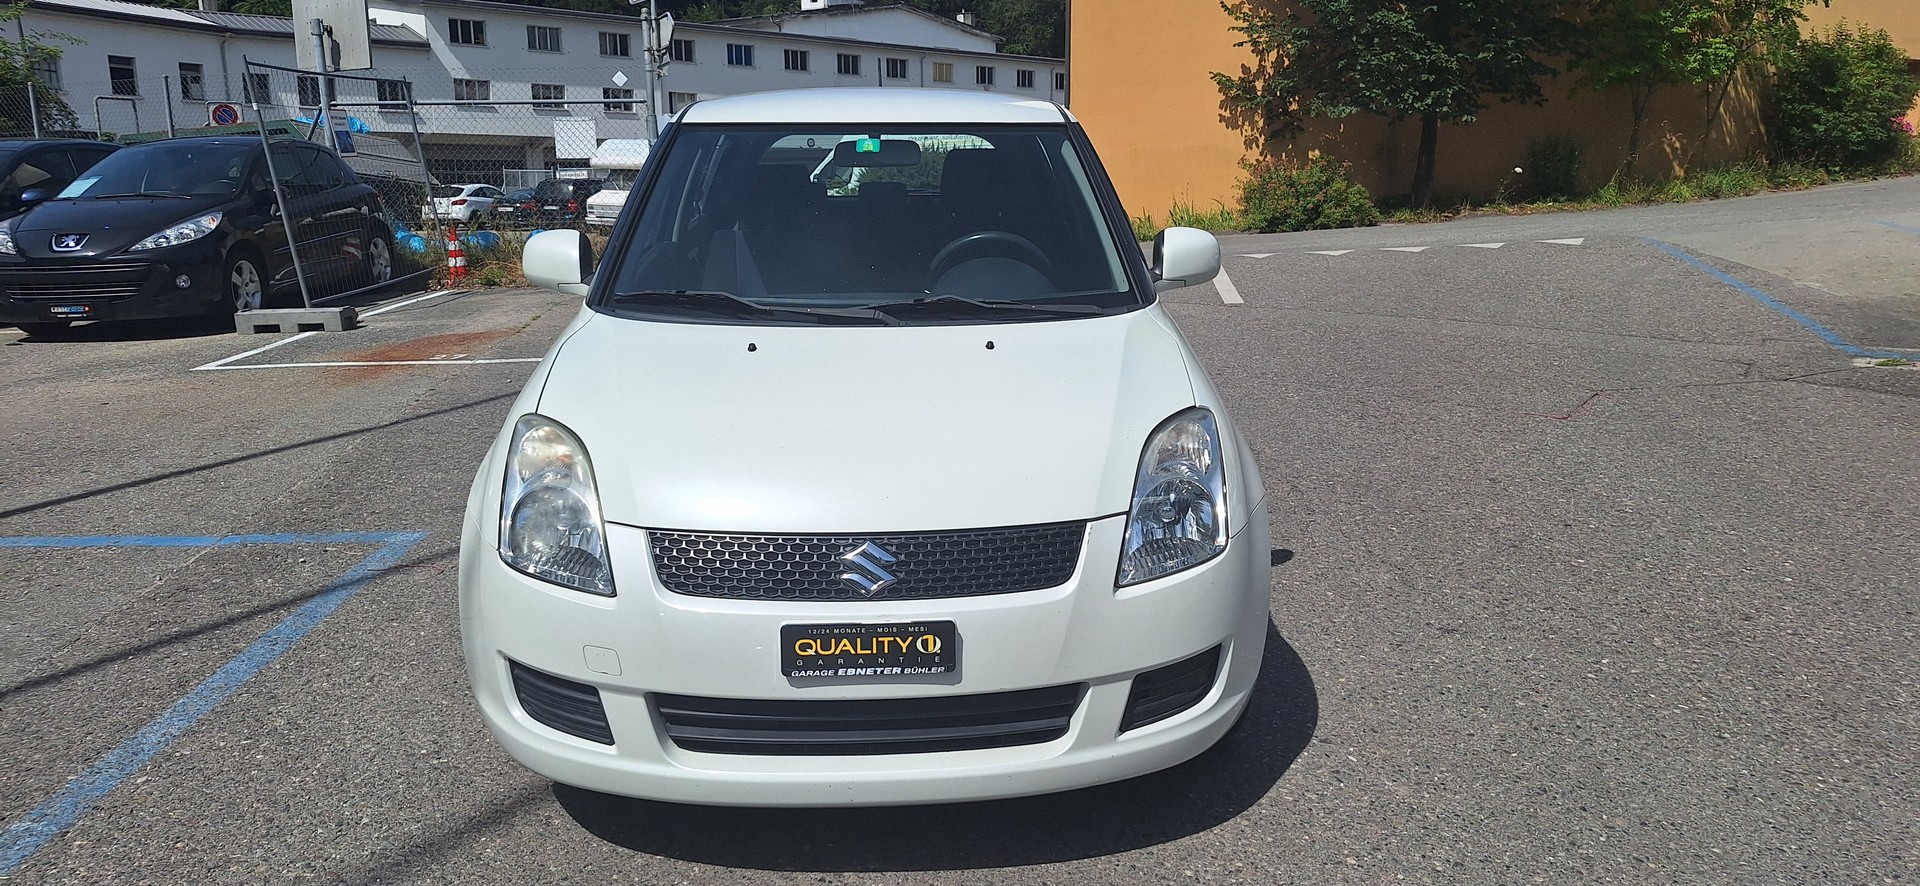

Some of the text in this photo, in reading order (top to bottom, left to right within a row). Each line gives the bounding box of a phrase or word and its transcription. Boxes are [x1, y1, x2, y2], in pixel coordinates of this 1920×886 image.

[795, 636, 913, 655] QUALITY
[796, 656, 941, 666] GARANTIE
[791, 666, 945, 677] GARAGE EBNETER BÜHLER
